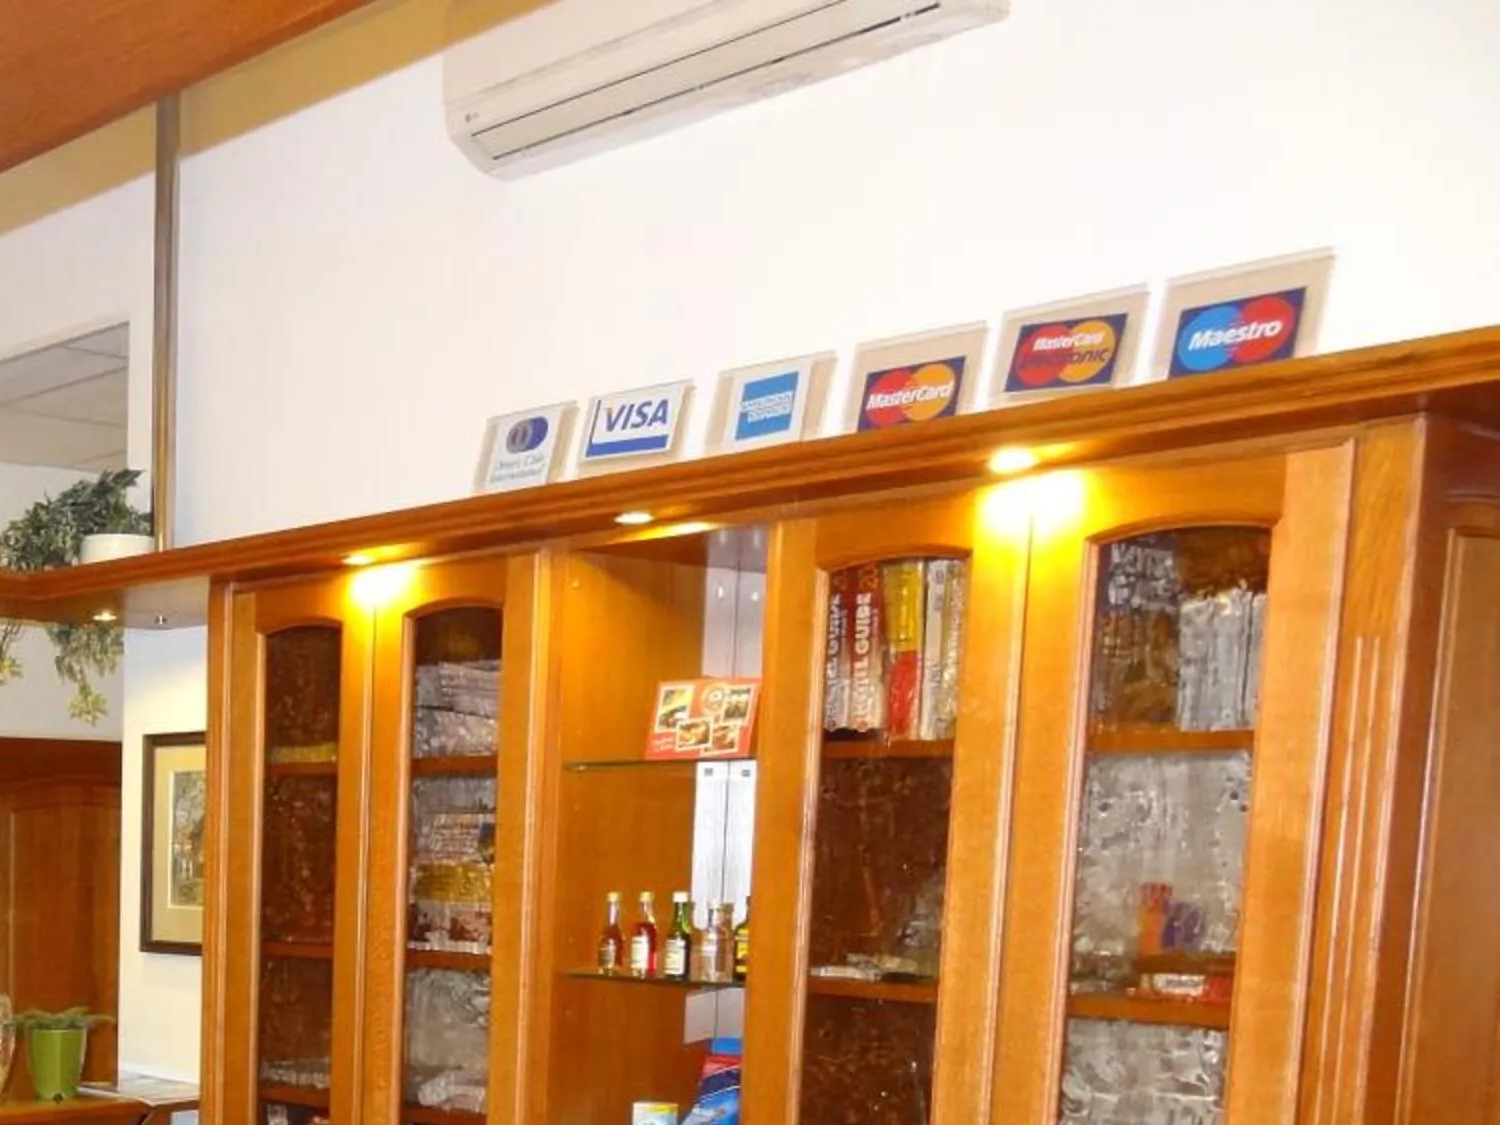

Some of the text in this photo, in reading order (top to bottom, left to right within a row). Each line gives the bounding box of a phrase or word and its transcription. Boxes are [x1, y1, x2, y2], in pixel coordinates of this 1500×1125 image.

[1188, 318, 1284, 351] Maestro
[866, 381, 954, 410] MasterCard
[605, 399, 669, 432] VISA
